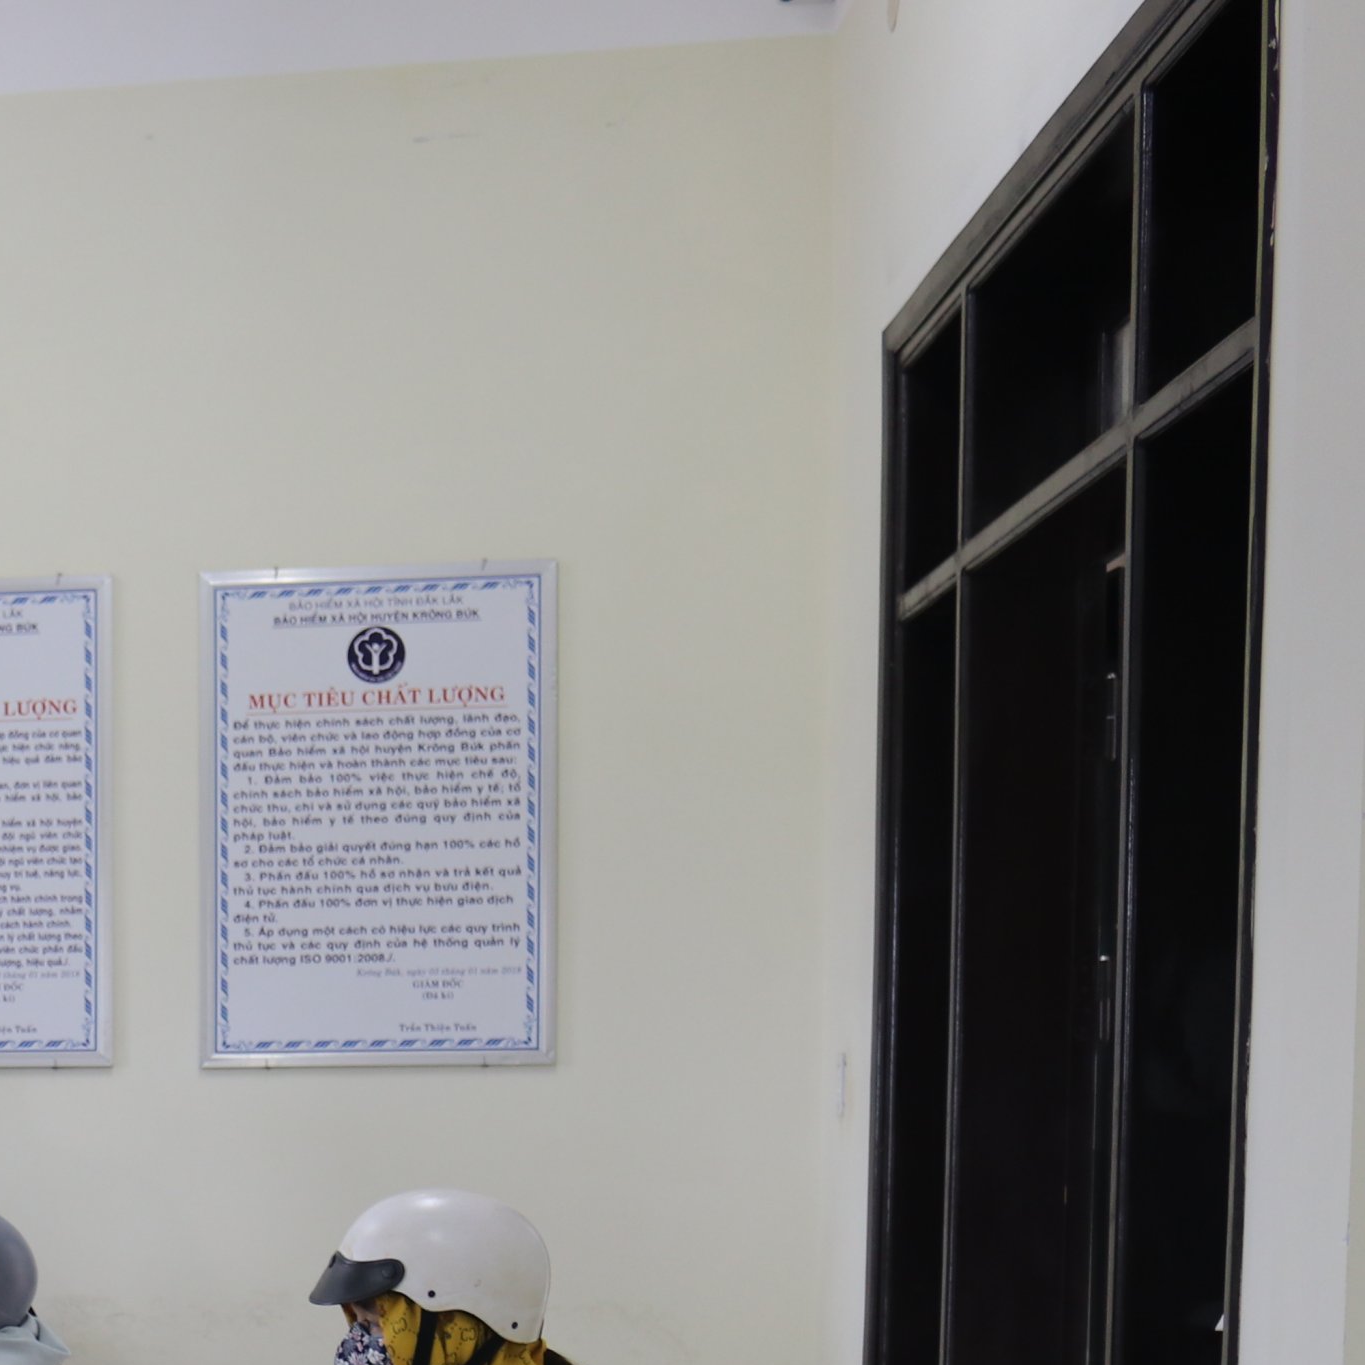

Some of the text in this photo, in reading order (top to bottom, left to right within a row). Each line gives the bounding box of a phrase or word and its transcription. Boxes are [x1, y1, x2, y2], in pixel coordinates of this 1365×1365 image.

[273, 614, 297, 626] BẢO
[300, 612, 327, 625] HIỂM
[348, 611, 368, 625] HỘI
[370, 609, 409, 624] HUYỆN
[412, 608, 452, 621] KRÔNG
[456, 607, 478, 619] BÚK
[16, 621, 38, 633] BÚK
[248, 681, 505, 714] MỤC TIÊU CHẤT LƯỢNG
[3, 697, 77, 722] LƯỢNG
[254, 719, 280, 731] thực
[285, 718, 311, 730] hiện
[316, 717, 350, 728] chính
[355, 716, 384, 726] sách
[388, 715, 415, 725] chất
[462, 713, 489, 723] lãnh
[233, 734, 254, 744] cán
[281, 732, 306, 743] viên
[310, 731, 339, 742] chức
[361, 730, 380, 740] lao
[383, 729, 414, 741] động
[418, 728, 441, 740] hợp
[445, 727, 476, 739] đồng
[480, 726, 502, 736] của
[233, 749, 263, 760] quan
[268, 747, 292, 757] Bảo
[297, 746, 326, 756] hiểm
[351, 744, 370, 756] hội
[374, 743, 412, 755] huyện
[417, 742, 455, 754] Krông
[460, 741, 484, 751] Búk
[489, 740, 520, 752] phấn
[233, 761, 256, 771] đấu
[259, 761, 285, 772] thực
[289, 760, 315, 772] hiện
[337, 758, 367, 768] hoàn
[371, 757, 406, 768] thành
[409, 756, 431, 766] các
[435, 757, 461, 767] mục
[465, 755, 488, 765] tiêu
[264, 774, 292, 784] Đảm
[299, 773, 322, 783] bảo
[330, 772, 362, 782] 100%
[369, 771, 394, 783] việc
[402, 770, 429, 782] thực
[436, 769, 464, 781] hiện
[471, 768, 494, 779] chế
[258, 844, 286, 853] Đảm
[290, 843, 312, 853] bảo
[316, 842, 338, 854] giải
[342, 841, 376, 853] quyết
[380, 841, 411, 852] đúng
[415, 840, 438, 852] hạn
[444, 839, 474, 849] 100%
[479, 838, 500, 848] các
[259, 871, 291, 881] Phấn
[295, 870, 319, 880] đấu
[324, 869, 355, 879] 100%
[399, 868, 430, 880] nhận
[453, 867, 471, 877] trả
[475, 866, 494, 876] kết
[498, 866, 521, 878] quả
[258, 899, 289, 908] Phấn
[293, 898, 315, 908] đấu
[320, 897, 350, 907] 100%
[355, 897, 378, 907] đơn
[396, 896, 422, 908] thực
[426, 895, 453, 907] hiện
[457, 895, 483, 906] giao
[487, 894, 513, 906] dịch
